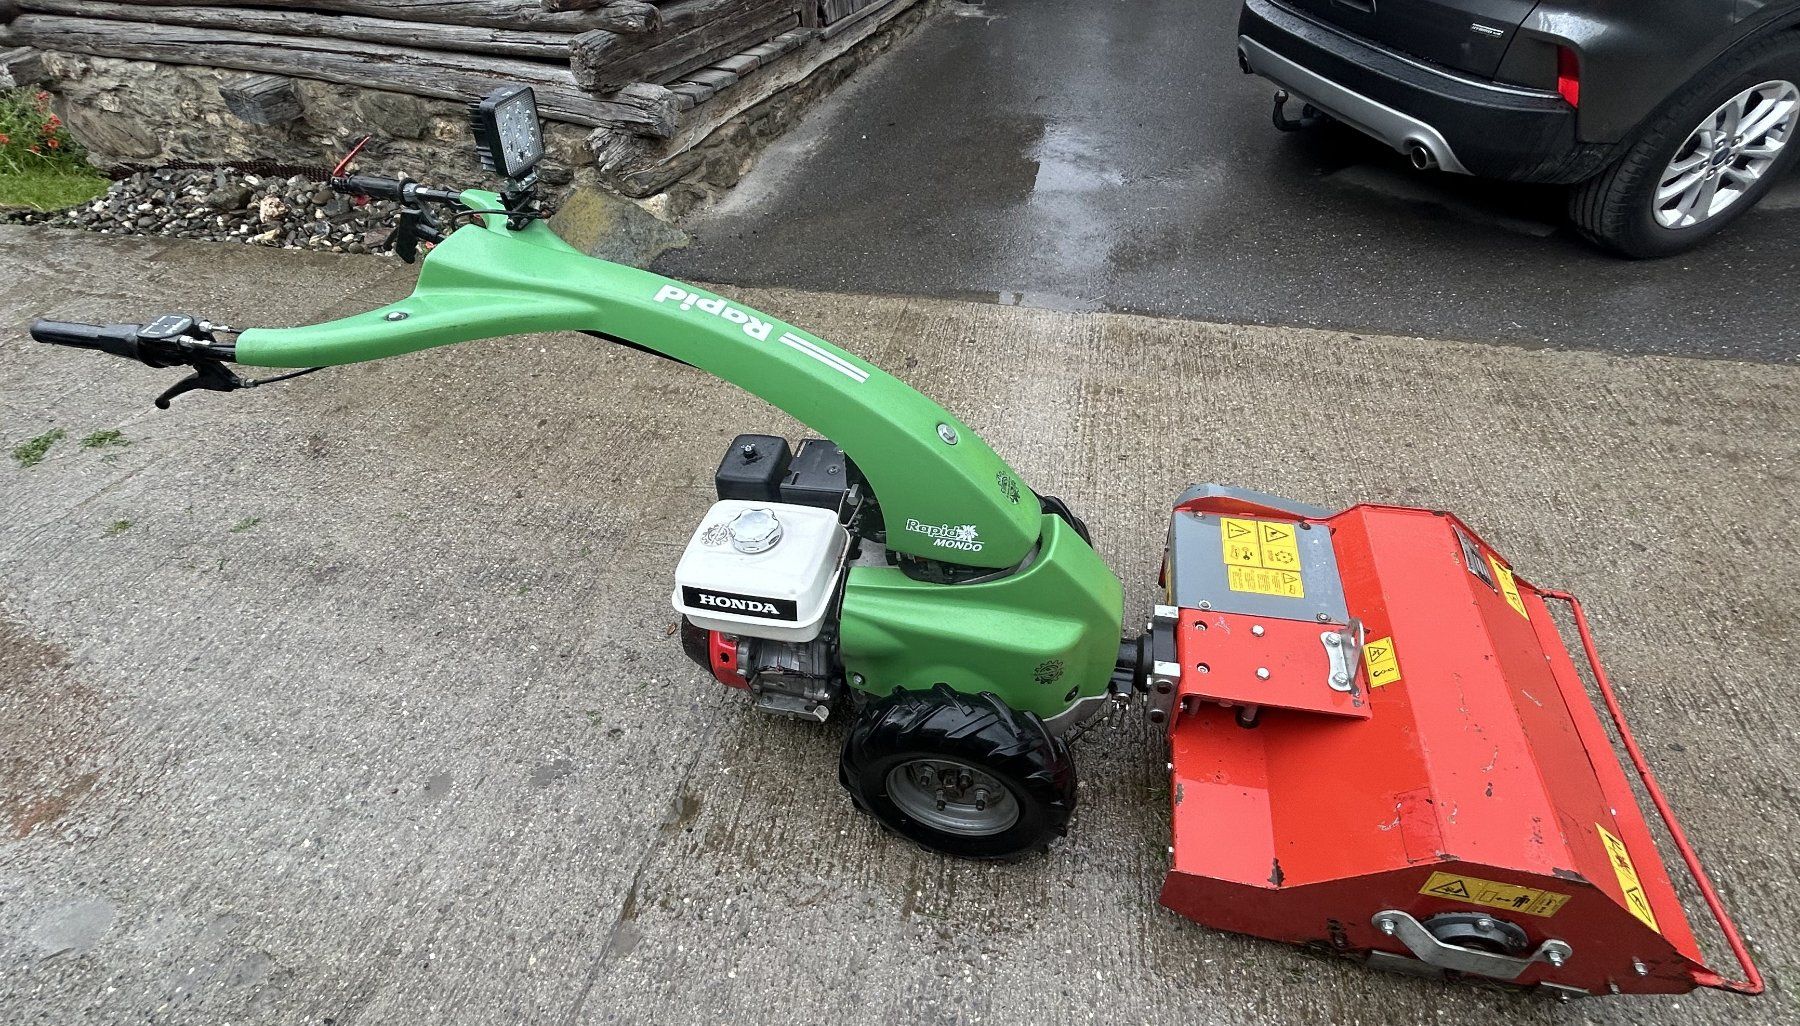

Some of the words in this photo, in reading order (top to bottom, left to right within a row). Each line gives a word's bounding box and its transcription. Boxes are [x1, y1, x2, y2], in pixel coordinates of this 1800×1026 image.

[653, 284, 774, 342] Rapid
[905, 518, 960, 538] Rapid
[933, 538, 983, 552] MONDO
[698, 593, 780, 615] HONDA
